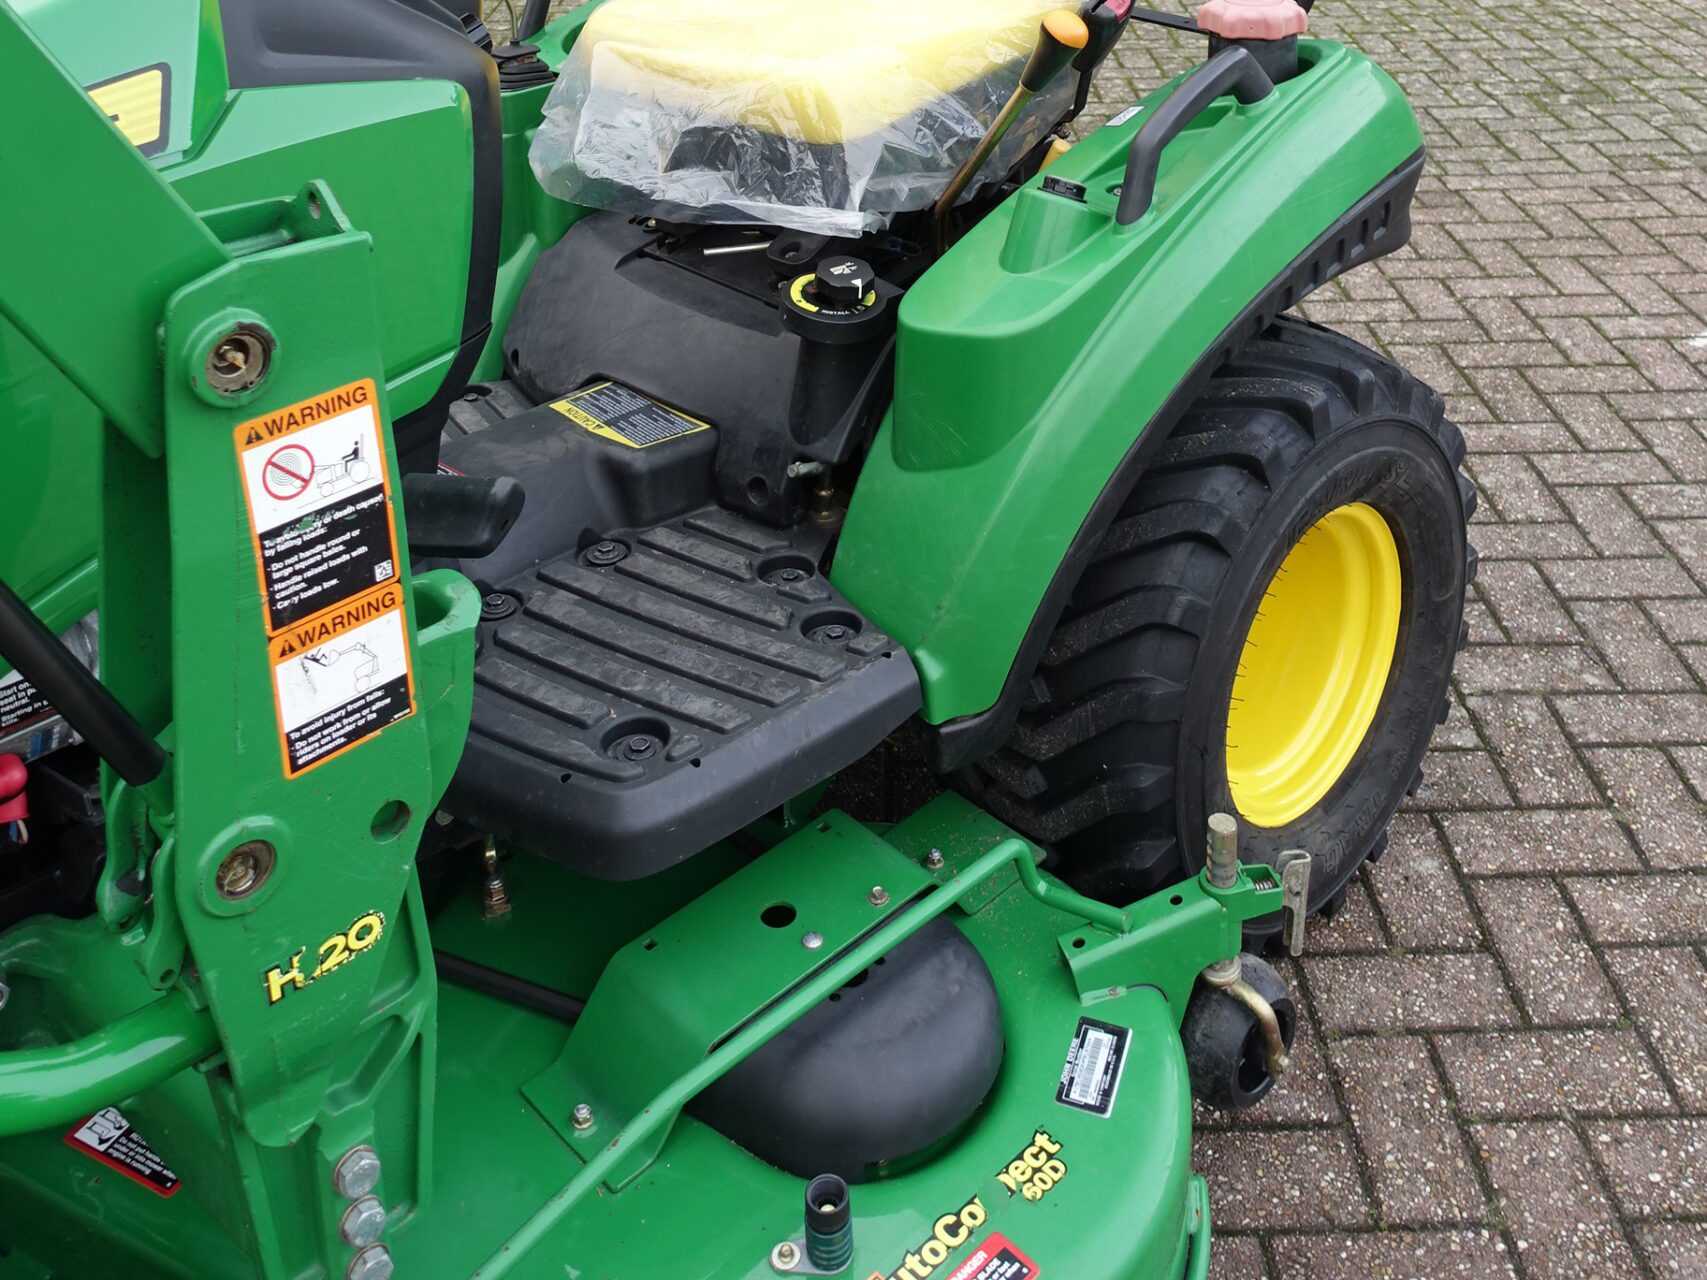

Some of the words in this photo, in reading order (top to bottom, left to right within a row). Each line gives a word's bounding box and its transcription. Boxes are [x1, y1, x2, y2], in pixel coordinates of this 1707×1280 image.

[264, 386, 368, 437] WARNING
[566, 407, 596, 426] CAUTION
[333, 505, 355, 519] death
[264, 548, 276, 557] by
[276, 537, 303, 552] falling
[303, 526, 328, 542] loads:
[271, 561, 284, 571] Do
[284, 555, 299, 566] not
[299, 544, 326, 559] handle
[326, 532, 351, 547] round
[351, 528, 361, 537] or
[272, 566, 294, 580] large
[294, 554, 322, 570] square
[322, 544, 346, 558] bales.
[273, 574, 303, 591] Handle
[303, 562, 329, 579] raised
[329, 552, 351, 567] loads
[351, 545, 368, 558] with
[275, 582, 308, 600] caution.
[300, 585, 322, 599] loads
[322, 578, 340, 589] low.
[297, 591, 396, 647] WARNING
[290, 732, 301, 740] To
[301, 719, 323, 735] avoid
[324, 708, 346, 723] injury
[347, 699, 365, 711] from
[366, 689, 385, 703] falls:
[295, 740, 307, 749] Do
[308, 732, 322, 743] not
[322, 722, 342, 735] work
[342, 712, 361, 725] from
[361, 708, 371, 716] or
[371, 697, 391, 711] allow
[296, 740, 320, 757] riders
[320, 735, 332, 745] on
[332, 722, 357, 739] loader
[357, 718, 366, 726] or
[366, 712, 377, 721] its
[297, 736, 347, 765] attachments.
[1060, 1063, 1073, 1084] JOHN
[976, 1257, 1001, 1280] BLADE
